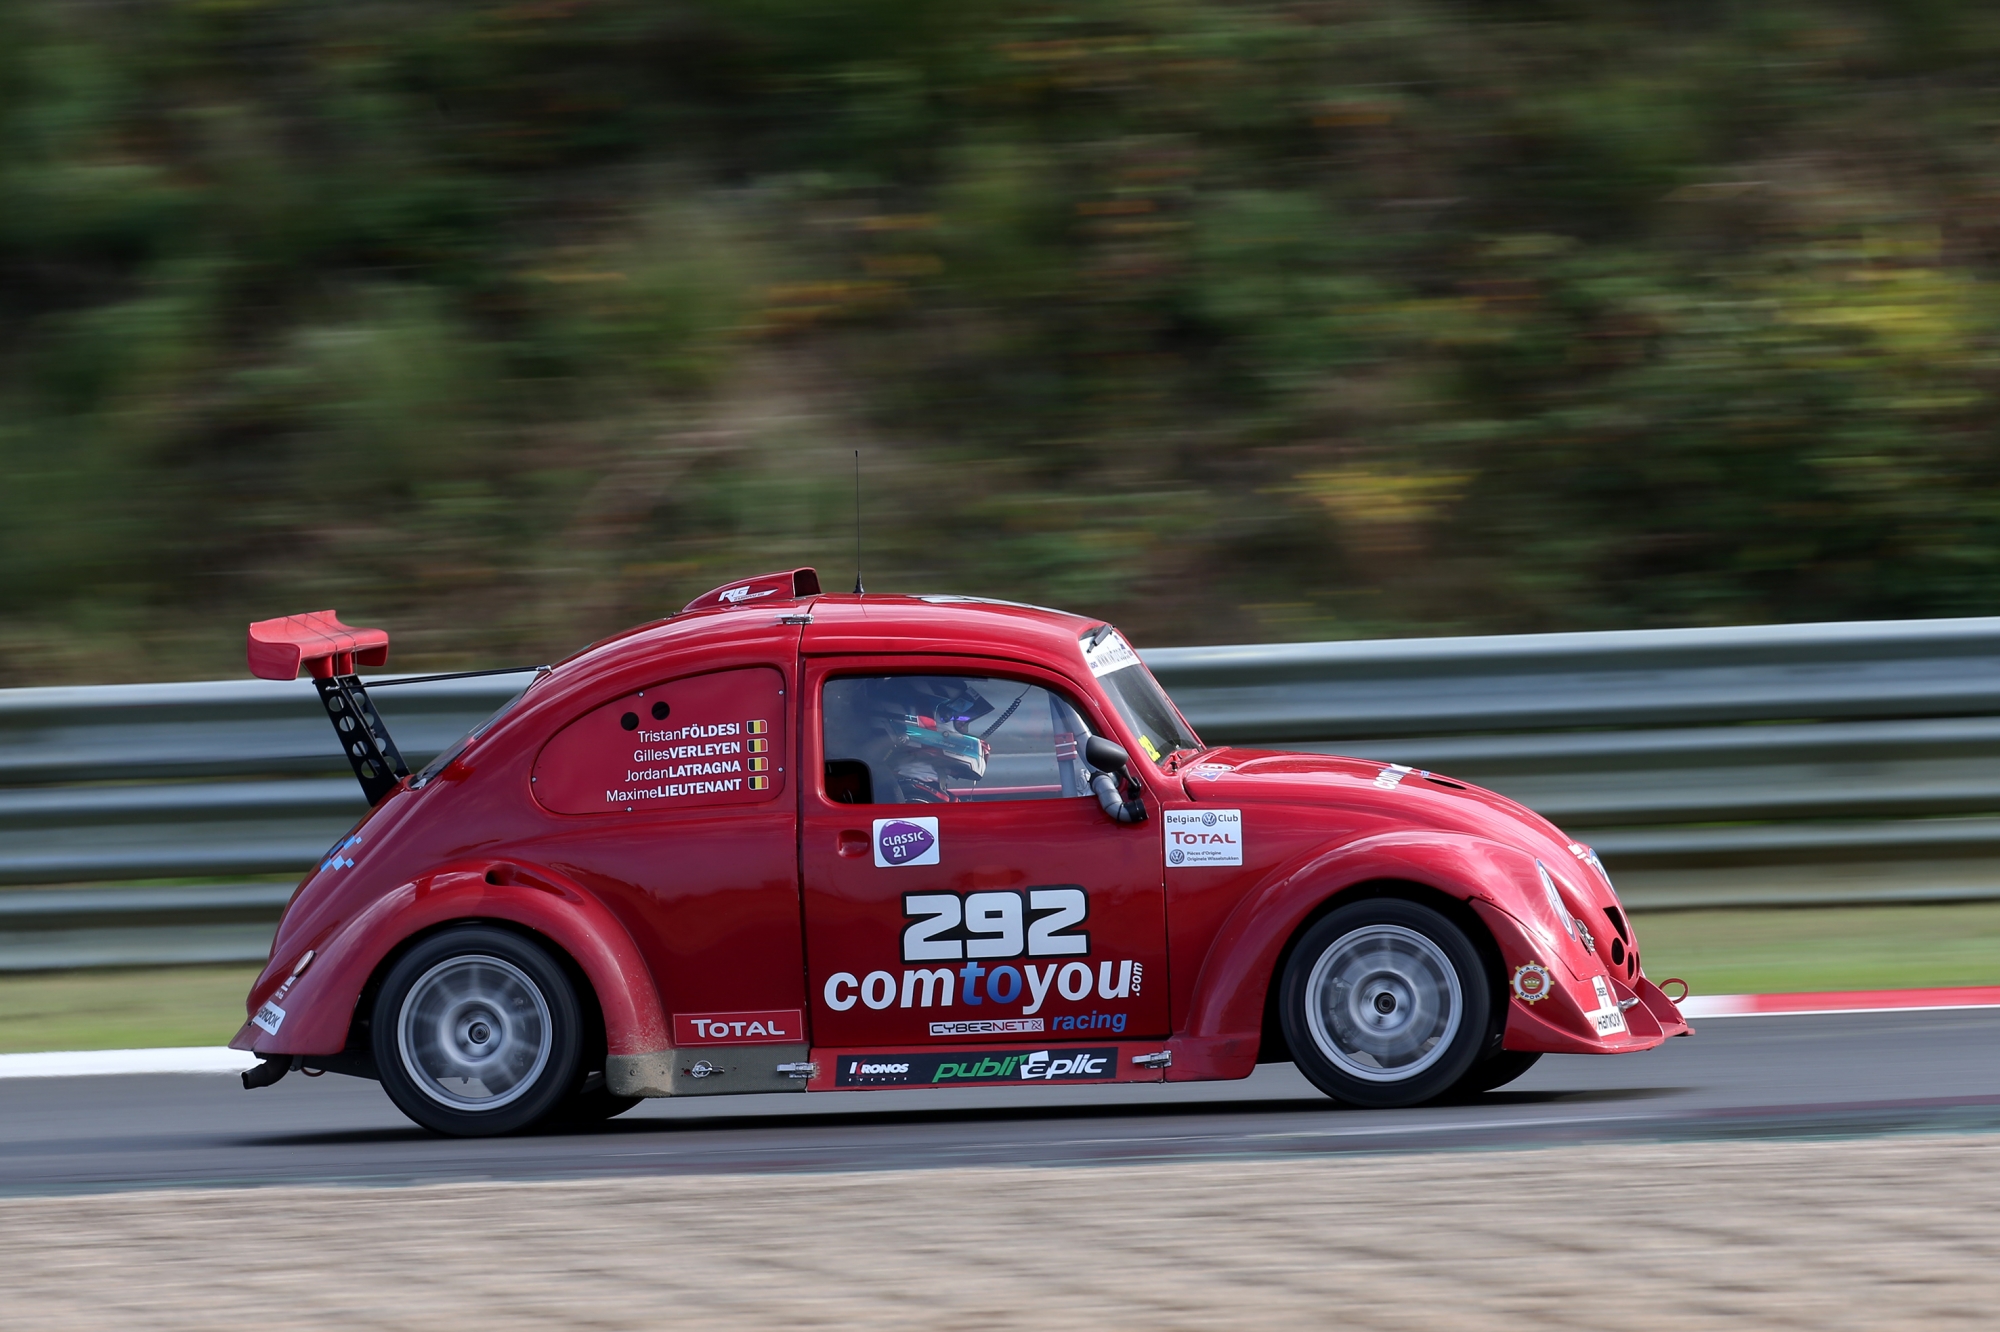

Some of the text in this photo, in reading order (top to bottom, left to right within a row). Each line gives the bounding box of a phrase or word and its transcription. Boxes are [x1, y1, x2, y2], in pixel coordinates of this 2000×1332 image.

[634, 741, 741, 762] GillesVERLEYEN
[625, 760, 741, 782] JordanLATRAGNA
[606, 779, 742, 802] MaximeLIEUTENANT
[1166, 815, 1200, 825] Belgian
[1218, 814, 1238, 822] Club
[882, 831, 924, 846] CLASSIC
[1170, 831, 1236, 845] TOTAL
[893, 845, 907, 858] 21
[903, 887, 1088, 961] 292
[823, 960, 1133, 1015] comtoyou
[1520, 991, 1544, 999] SPORT
[691, 1019, 785, 1038] TOTAL
[1052, 1010, 1127, 1033] racing
[849, 1060, 909, 1074] KRONOS
